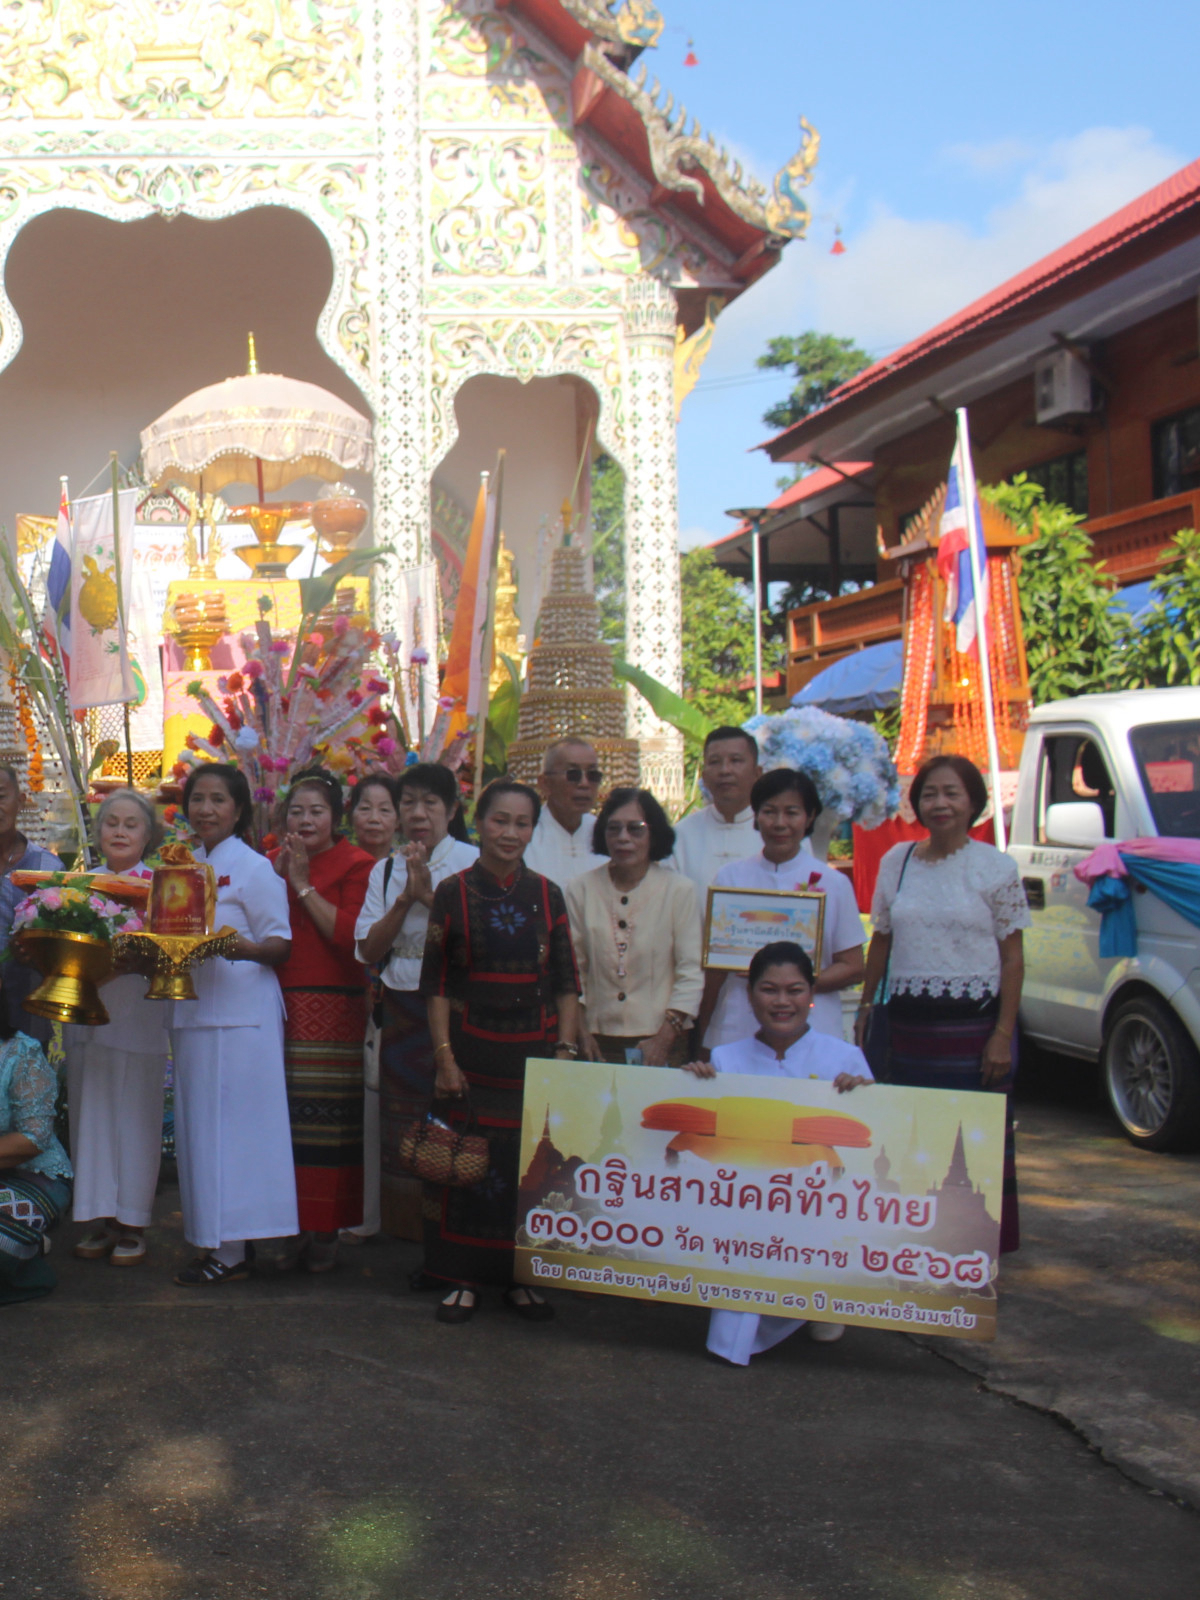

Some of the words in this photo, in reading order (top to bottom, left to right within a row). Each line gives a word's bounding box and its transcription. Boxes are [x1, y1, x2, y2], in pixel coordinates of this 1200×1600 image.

[579, 1158, 931, 1227] กฐินสามัคคีทั่วไทย
[531, 1213, 663, 1247] ๓๐,๐๐๐
[675, 1226, 704, 1252] วัด
[713, 1236, 848, 1268] พุทธศักราช
[861, 1244, 983, 1283] ๒๕๖๘
[533, 1259, 561, 1276] โดย
[567, 1267, 691, 1294] คณะศิษยานุศิษย์
[699, 1284, 775, 1304] บูชาธรรม
[814, 1293, 826, 1310] ปี
[833, 1299, 974, 1327] หลวงพ่อธัมมชโย
